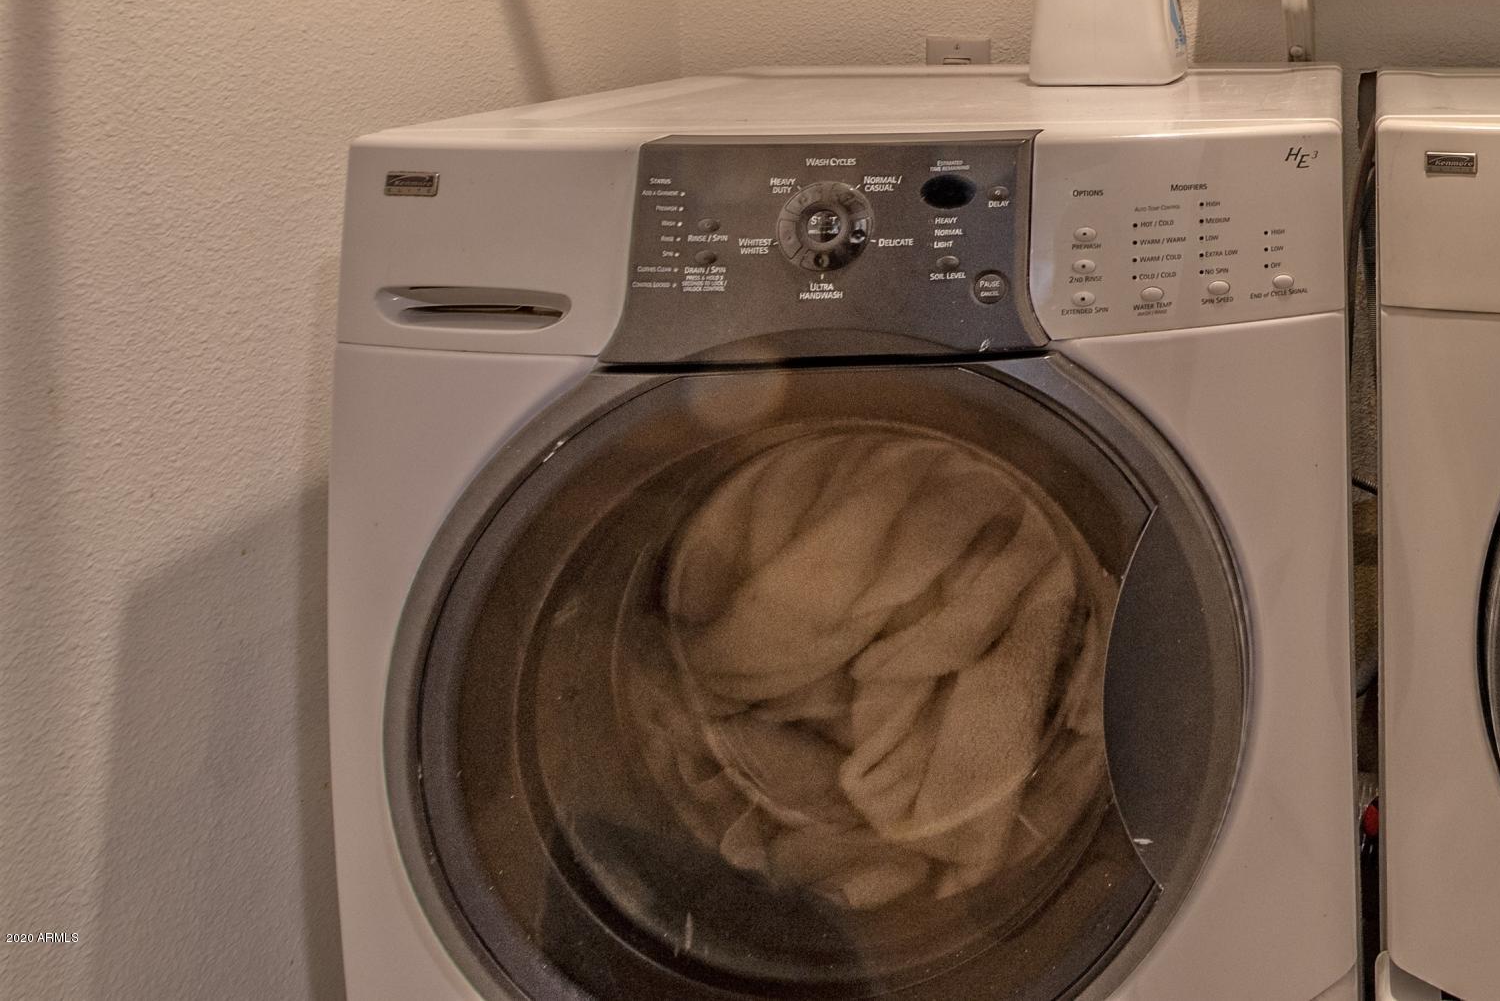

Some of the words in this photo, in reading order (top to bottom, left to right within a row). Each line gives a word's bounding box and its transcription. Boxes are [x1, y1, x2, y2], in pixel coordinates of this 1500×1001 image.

[806, 158, 829, 166] WASH
[830, 157, 857, 166] CYCLES
[770, 177, 796, 186] HEAVY
[864, 176, 896, 184] NORMAL
[772, 186, 792, 194] DUTY
[865, 184, 894, 192] CASUAL
[1170, 183, 1208, 192] MODIFIERS
[1072, 189, 1104, 197] OPTIONS
[988, 200, 1009, 208] DELAY
[934, 228, 963, 236] NORMAL
[712, 234, 728, 242] SPIN
[738, 238, 772, 246] WHITEST
[878, 238, 914, 246] DELICATE
[1140, 238, 1161, 246] WARM
[934, 240, 954, 248] LIGHT
[1205, 250, 1223, 258] EXTRA
[684, 266, 704, 274] DRAIN
[980, 280, 1000, 288] PAUSE
[1068, 276, 1083, 284] 2ND
[810, 283, 834, 291] ULTRA
[799, 291, 843, 300] HANDWASH
[1250, 292, 1262, 300] END
[1270, 290, 1288, 298] CYCLE
[1288, 287, 1308, 295] SIGNAL
[1201, 298, 1214, 306] SPIN
[1216, 296, 1234, 304] SPEED
[1061, 308, 1093, 316] EXTENDED
[1094, 306, 1109, 314] SPIN
